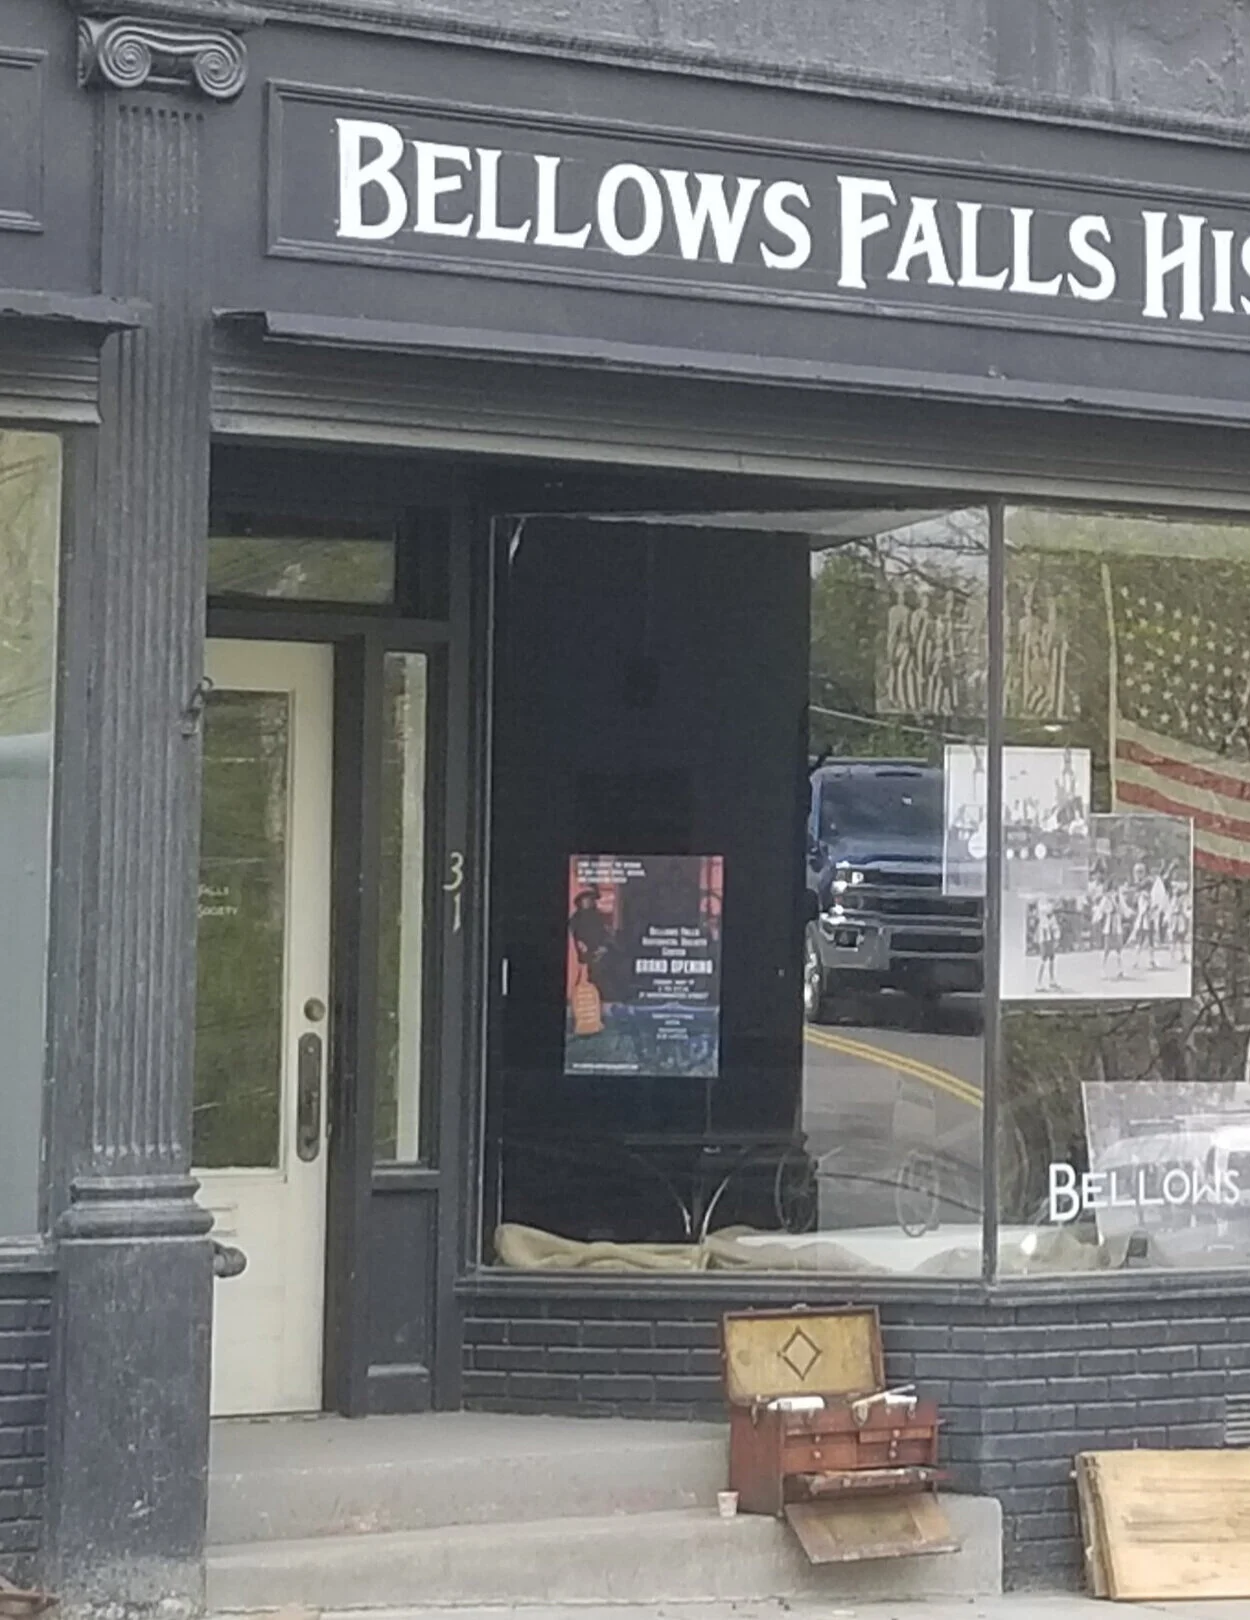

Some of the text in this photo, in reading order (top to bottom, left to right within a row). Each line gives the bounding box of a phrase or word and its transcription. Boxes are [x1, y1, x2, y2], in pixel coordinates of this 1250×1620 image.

[336, 118, 811, 270] BELLOWS
[837, 175, 1117, 301] FALLS
[1048, 1162, 1241, 1222] BELLOWS
